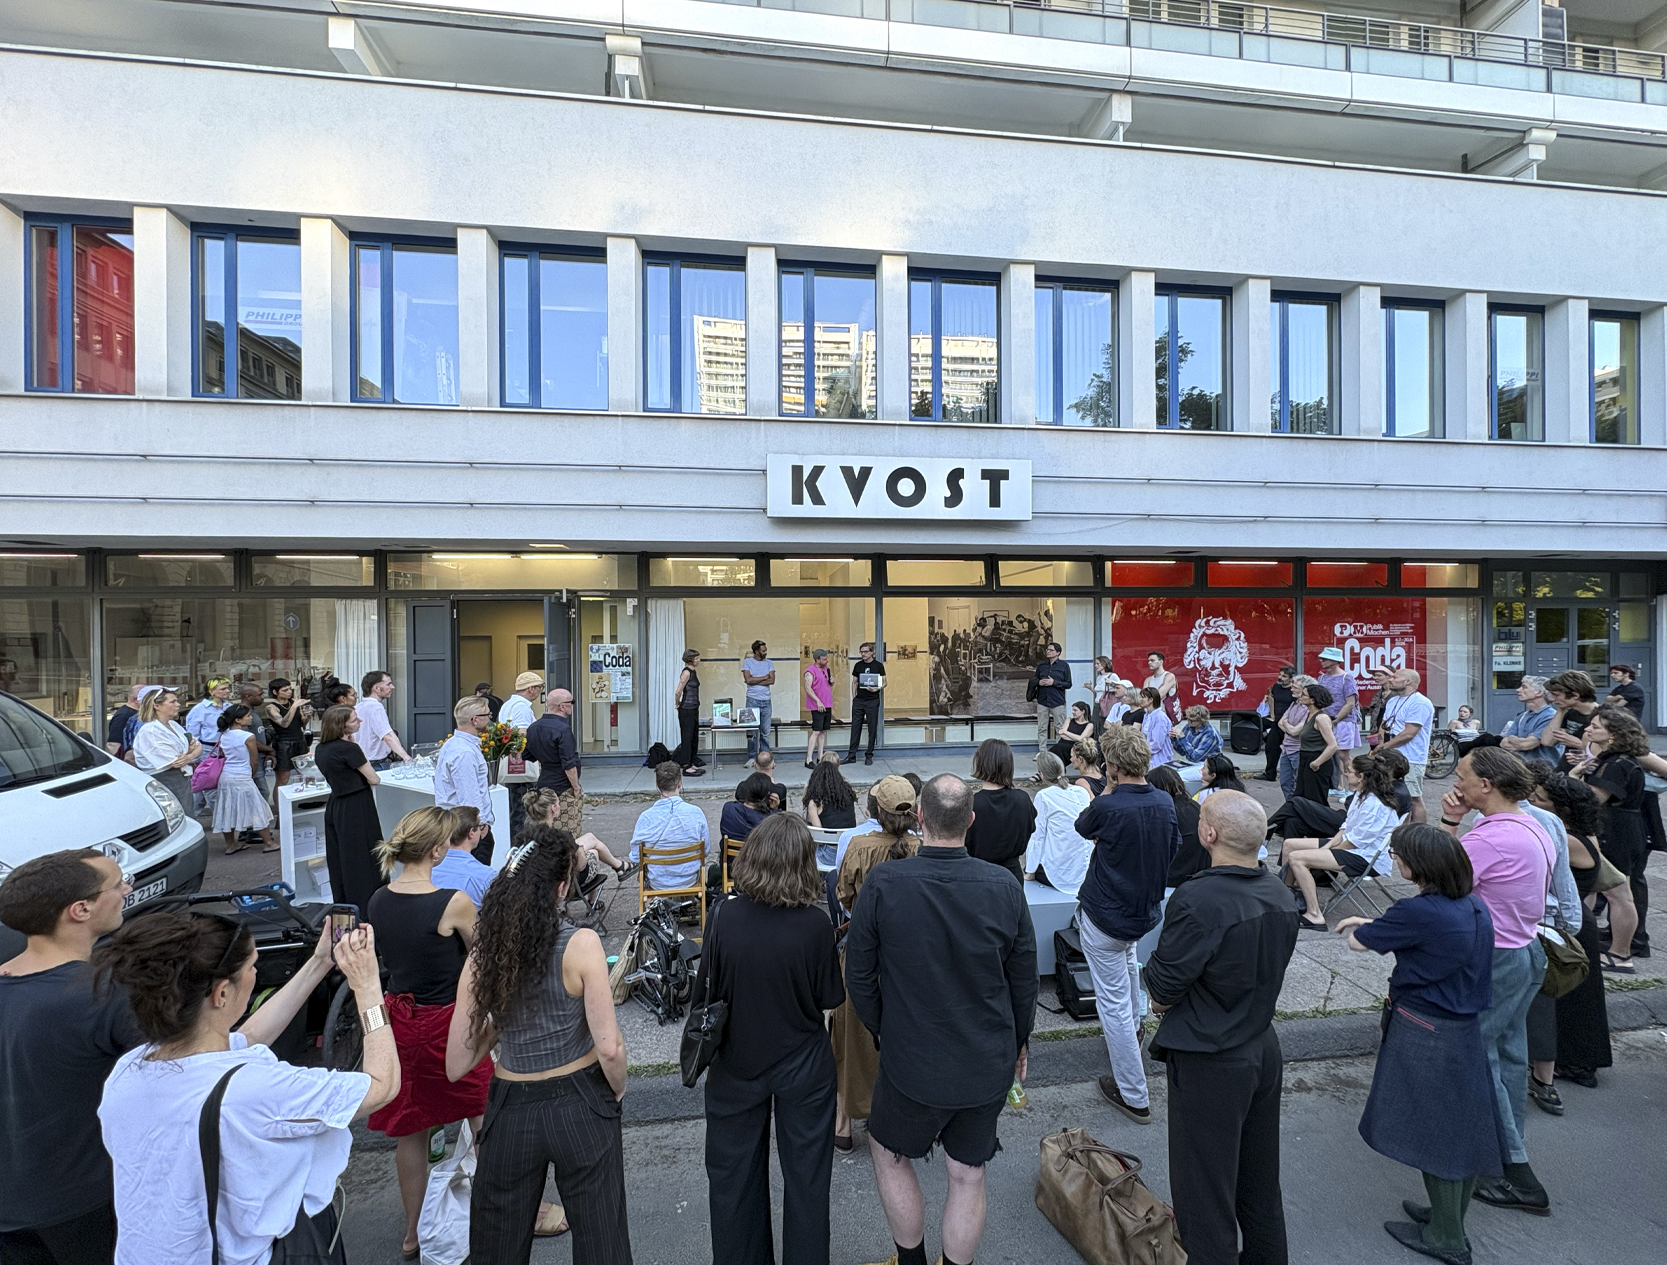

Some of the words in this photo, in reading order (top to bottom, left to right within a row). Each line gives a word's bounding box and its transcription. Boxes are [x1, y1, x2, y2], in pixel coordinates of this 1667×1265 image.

[245, 311, 302, 321] PHILIPP
[791, 465, 1010, 509] KVOST
[603, 652, 631, 668] Coda
[1344, 638, 1406, 678] Coda
[138, 881, 166, 902] 2121
